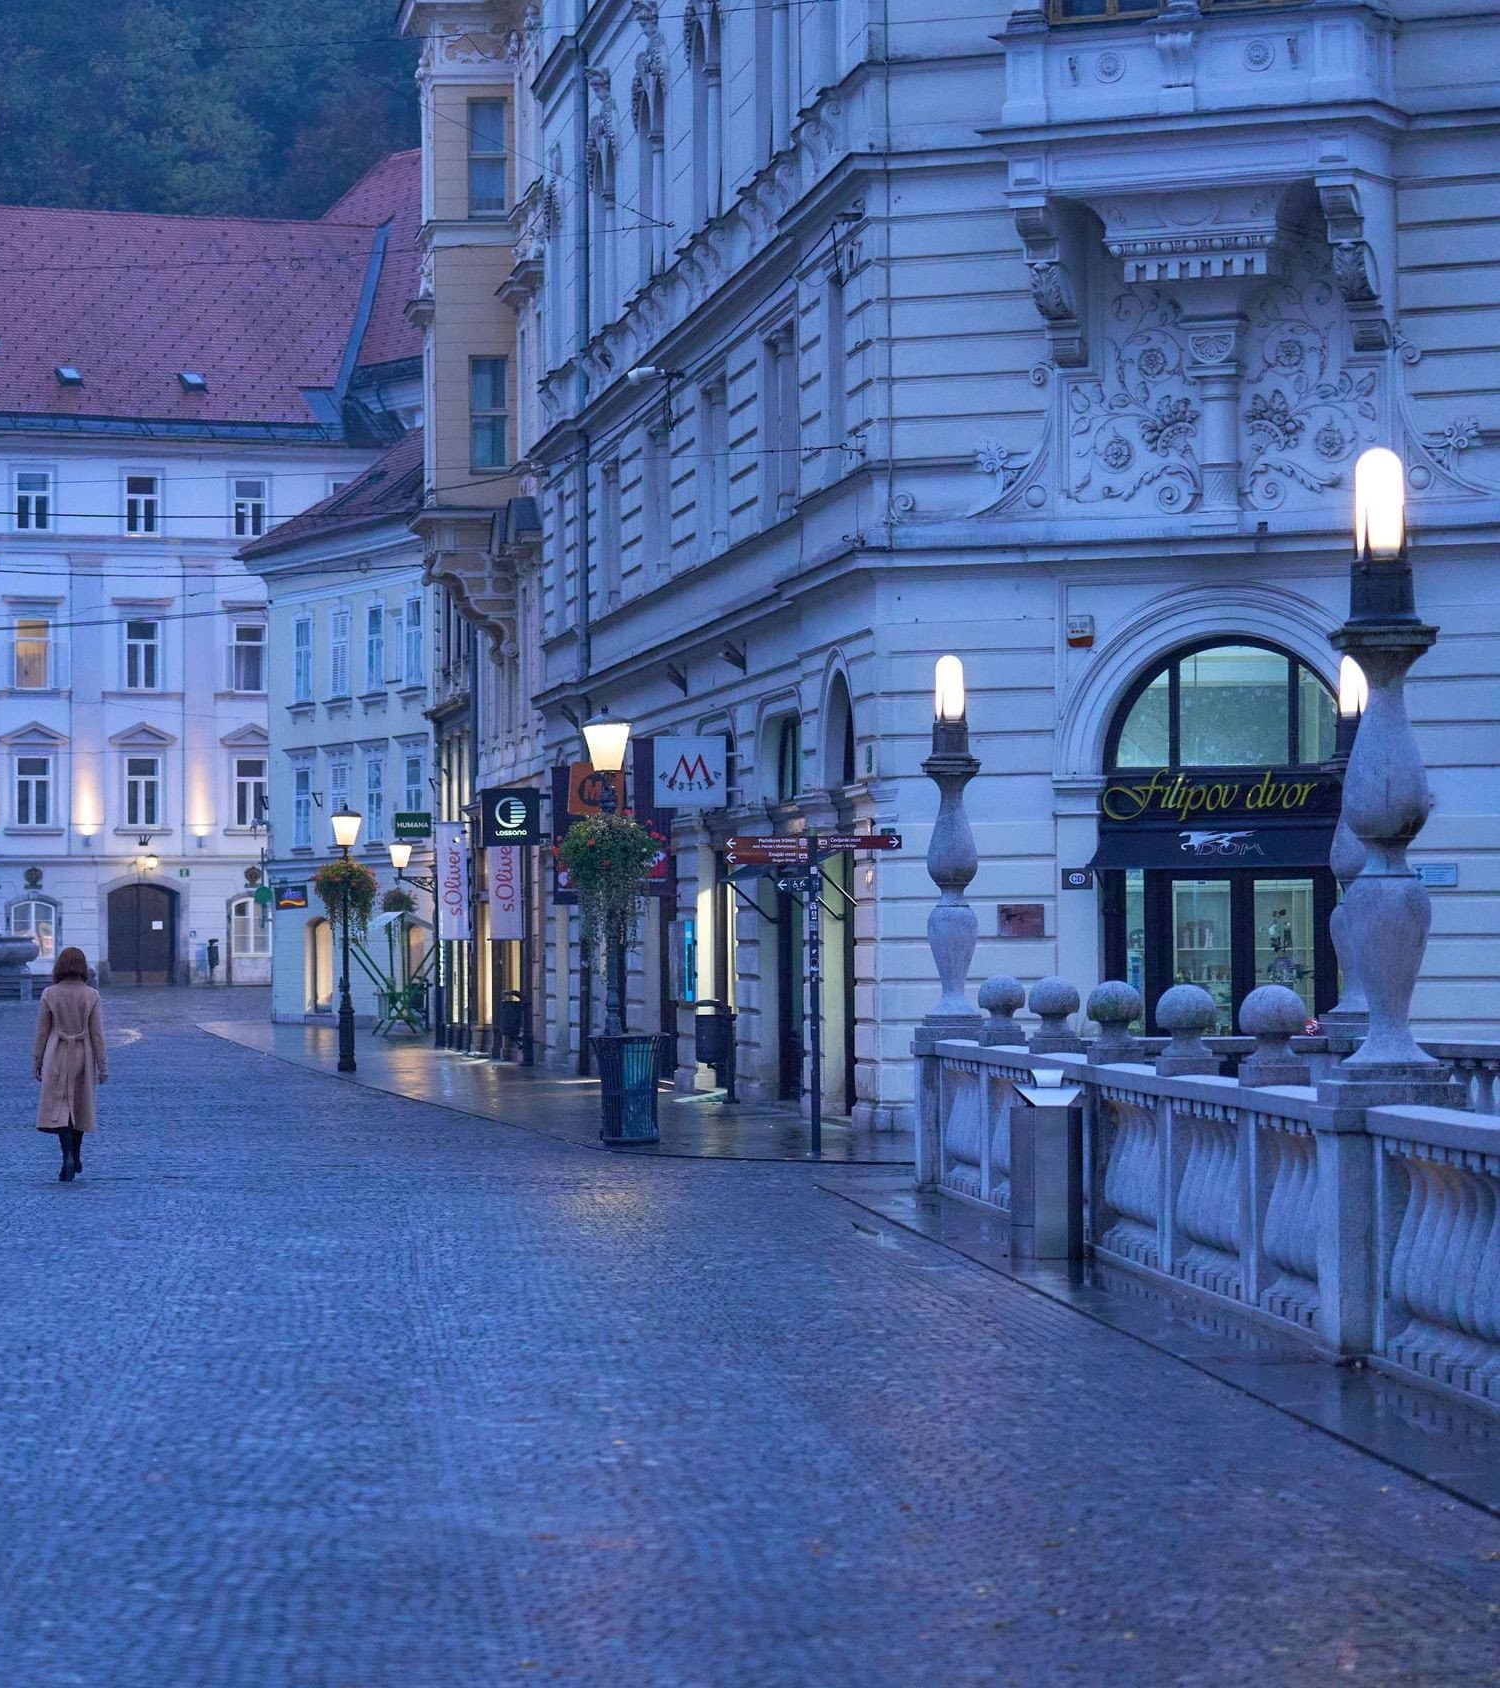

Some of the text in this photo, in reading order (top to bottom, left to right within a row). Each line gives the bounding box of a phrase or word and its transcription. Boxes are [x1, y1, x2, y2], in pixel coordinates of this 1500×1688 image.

[1102, 768, 1318, 822] Filipov dvor
[495, 846, 515, 912] s.Olive
